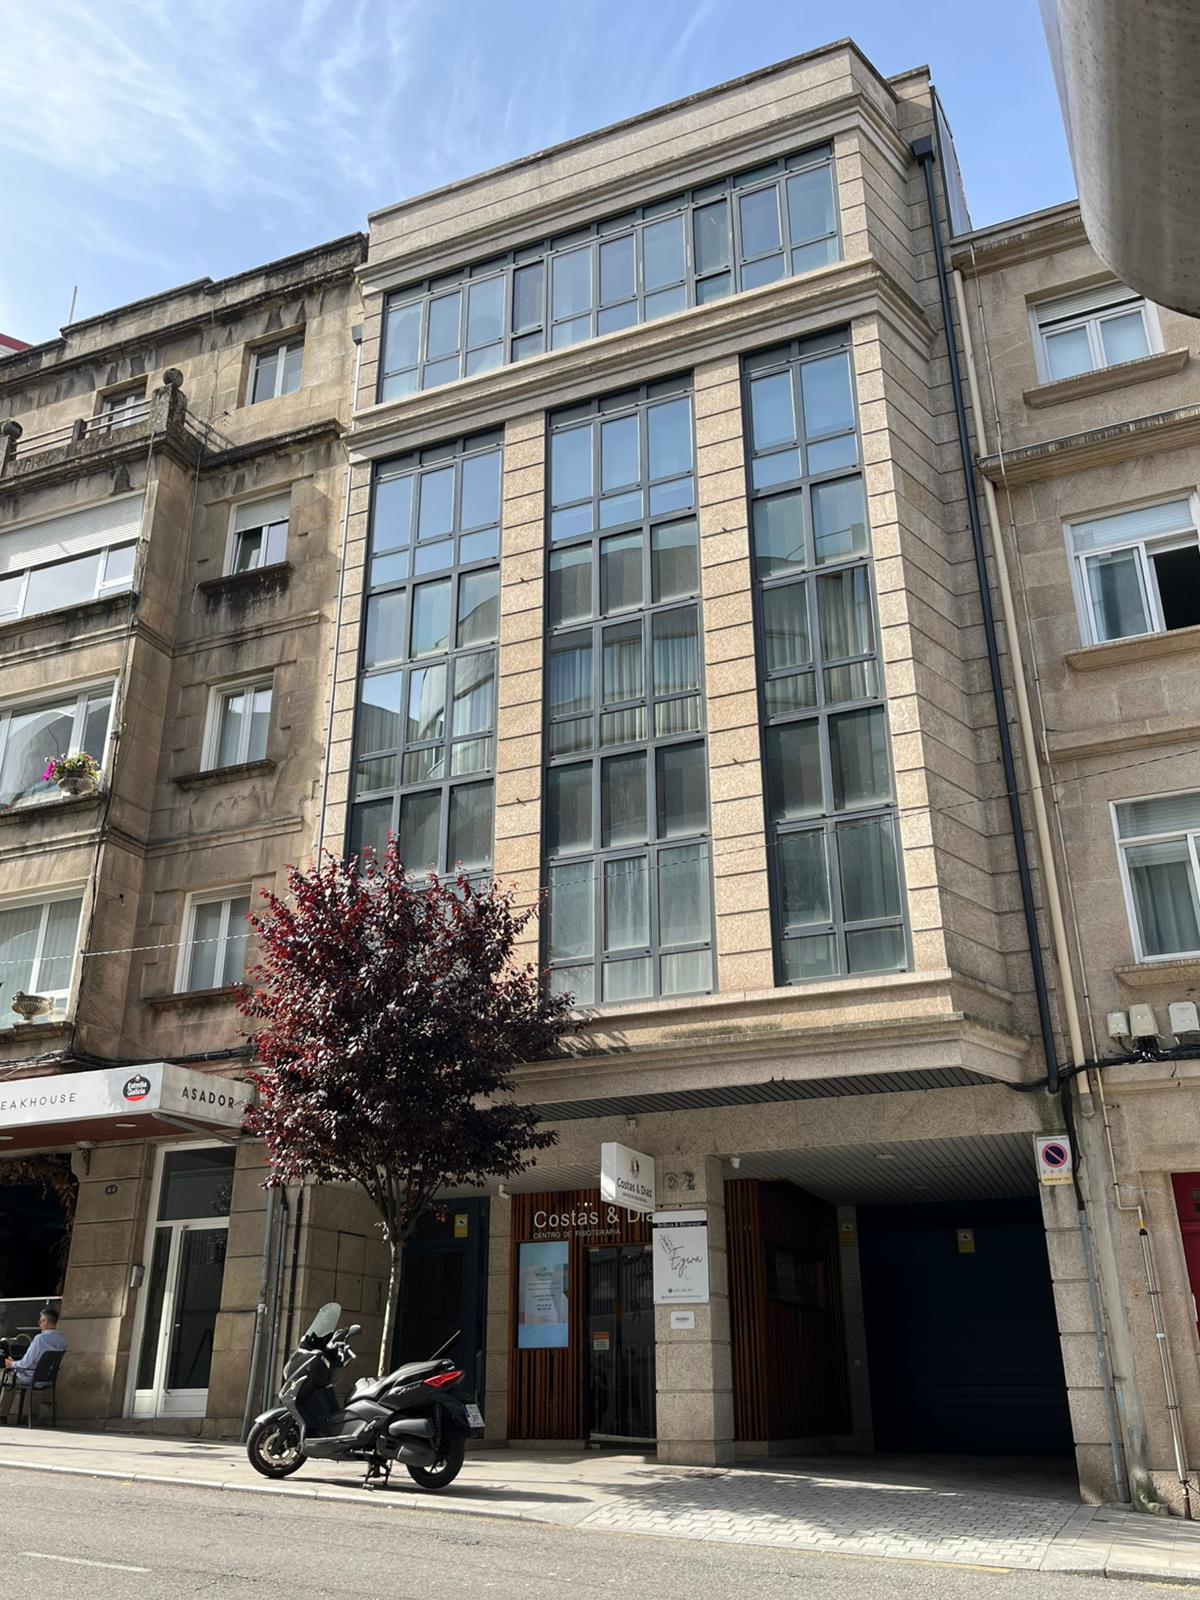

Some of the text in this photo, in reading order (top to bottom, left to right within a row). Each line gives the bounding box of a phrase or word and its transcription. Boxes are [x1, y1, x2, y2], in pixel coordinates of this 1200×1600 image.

[0, 1092, 76, 1111] EAKHOUSE
[181, 1086, 234, 1109] ASADOR
[616, 1177, 635, 1192] Costas
[534, 1209, 598, 1228] Costas
[607, 1206, 620, 1224] &
[533, 1231, 560, 1239] CENTRO
[563, 1230, 572, 1238] DE
